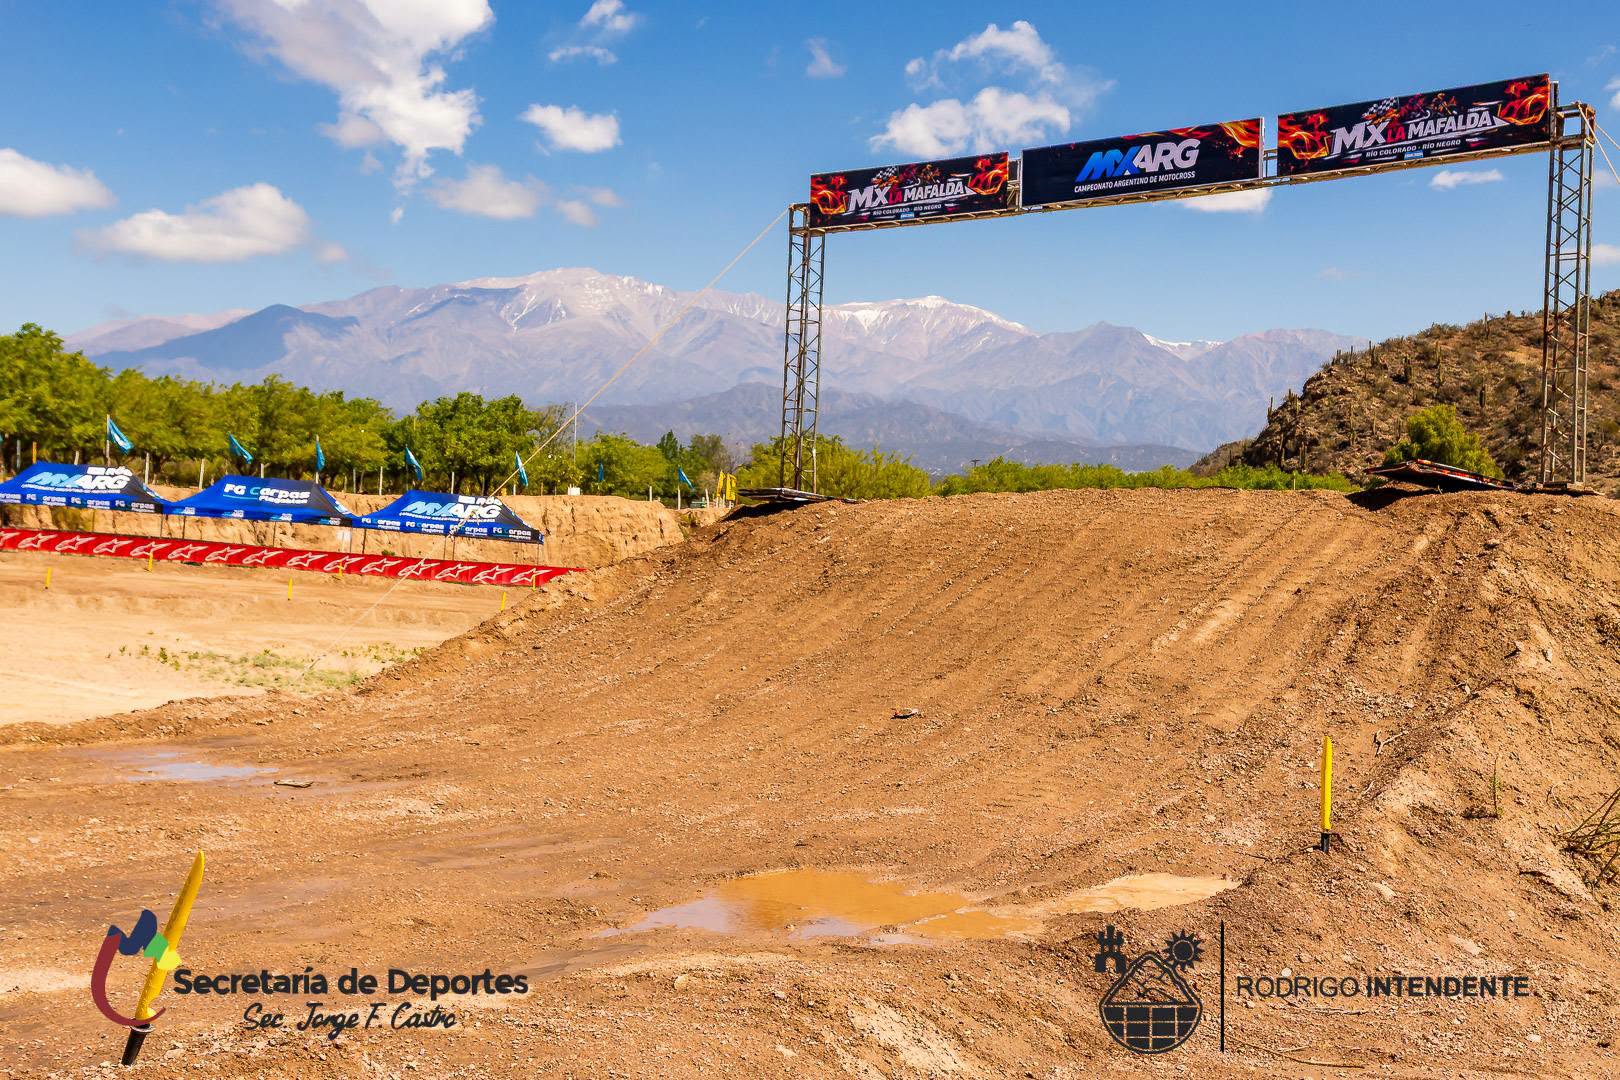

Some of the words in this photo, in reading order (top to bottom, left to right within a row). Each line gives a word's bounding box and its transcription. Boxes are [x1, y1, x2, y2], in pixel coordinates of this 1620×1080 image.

[1329, 120, 1391, 155] MX
[1387, 127, 1406, 144] LA
[1407, 110, 1492, 140] MAFALDA
[1366, 150, 1378, 158] RÍO
[1379, 145, 1417, 156] COLORADO
[1422, 142, 1435, 150] RÍO
[1436, 139, 1461, 148] NEGRO
[1074, 181, 1113, 193] CAMPEONATO
[1113, 177, 1149, 188] ARGENTINO
[1149, 175, 1158, 183] DE
[1158, 171, 1196, 182] MOTOCROSS
[848, 185, 892, 212] MX
[889, 191, 903, 205] LA
[903, 180, 966, 202] MAFALDA
[882, 207, 910, 215] COLORADO
[224, 483, 247, 495] FG
[250, 486, 311, 499] Carpas
